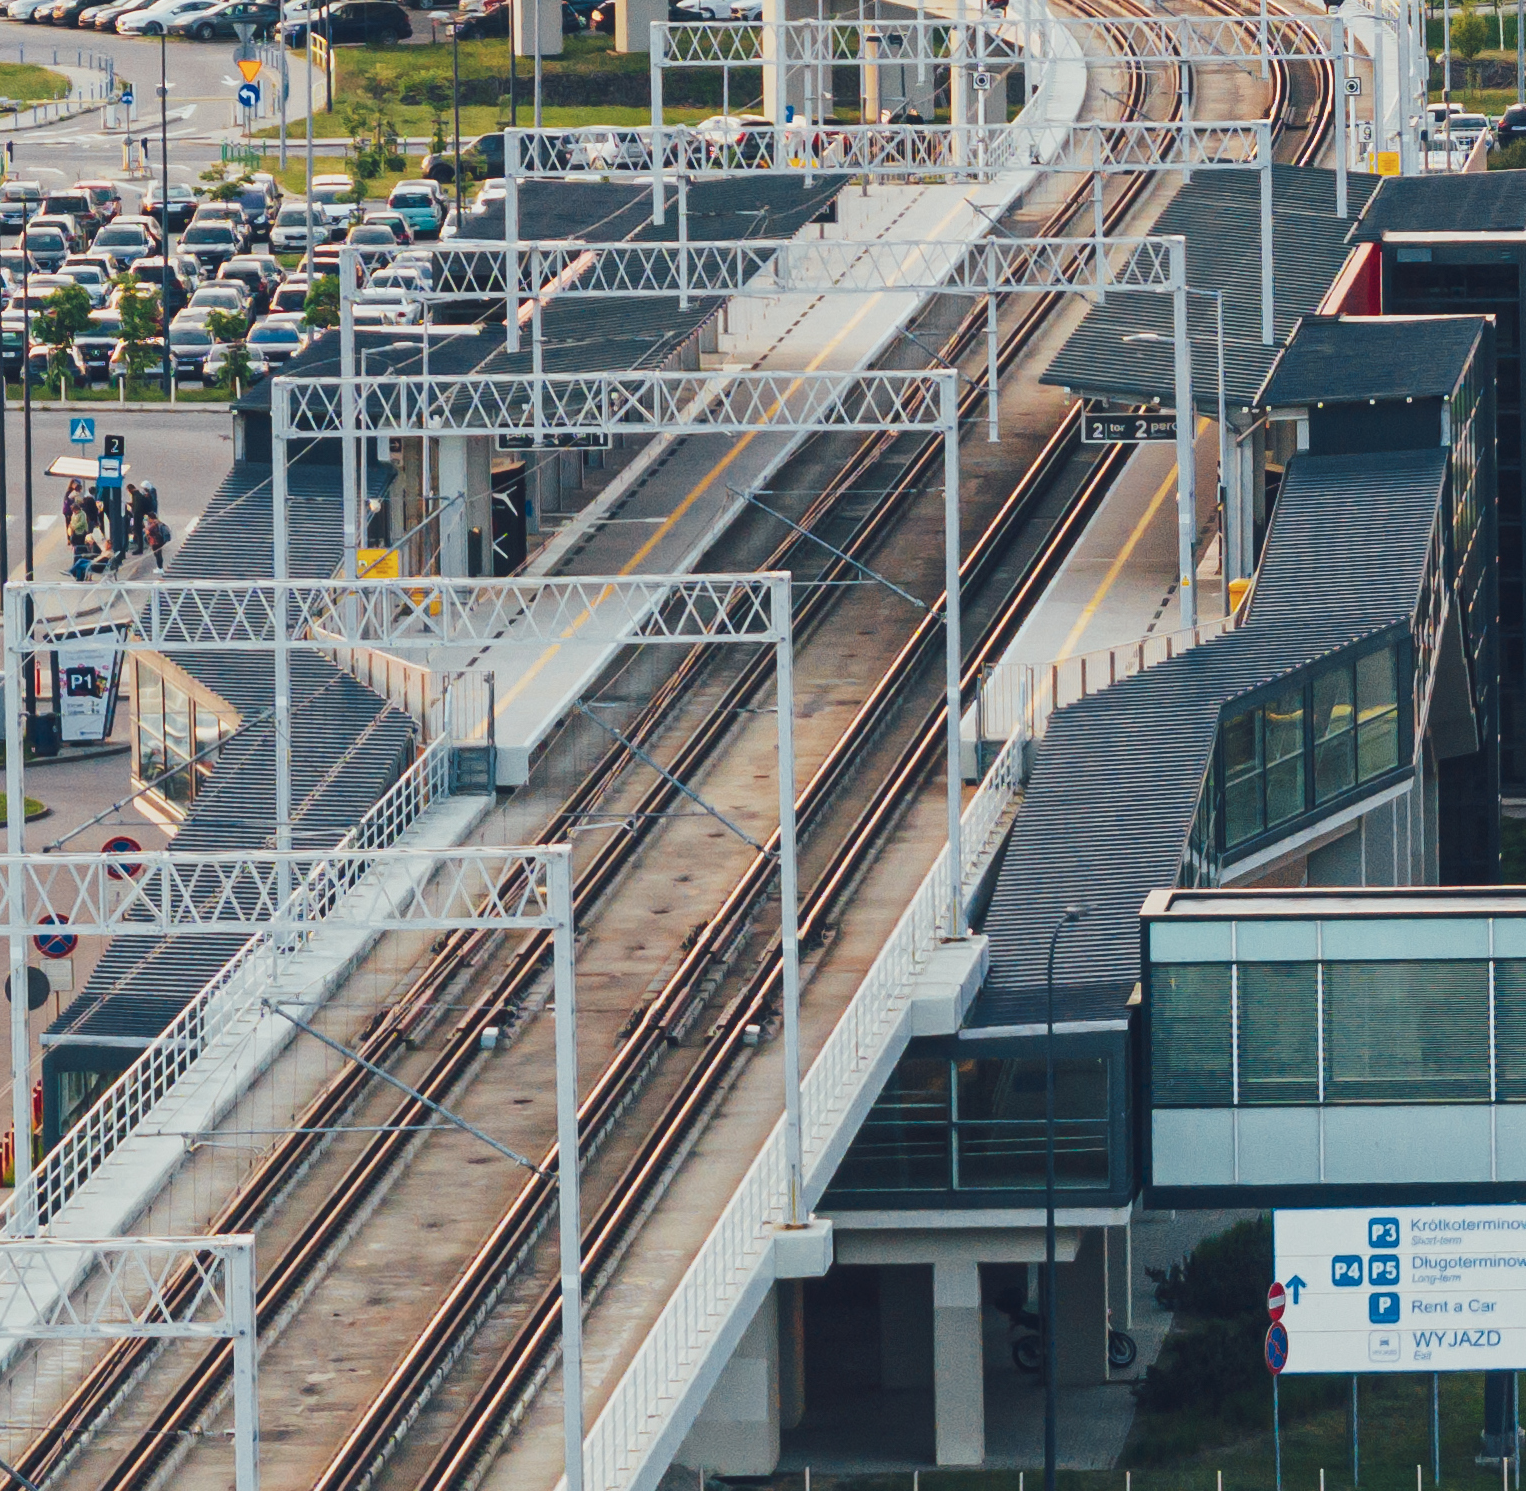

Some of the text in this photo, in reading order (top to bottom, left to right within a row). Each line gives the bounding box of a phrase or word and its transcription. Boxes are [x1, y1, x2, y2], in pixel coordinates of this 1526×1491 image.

[1093, 420, 1177, 438] 2 tor 2 pero
[111, 439, 119, 452] 2
[71, 674, 91, 689] P1
[1372, 1224, 1397, 1242] P3
[1335, 1262, 1360, 1279] P4
[1372, 1261, 1397, 1279] P5
[1379, 1297, 1497, 1314] P Rent a Car
[1413, 1330, 1502, 1348] WYJAZD
